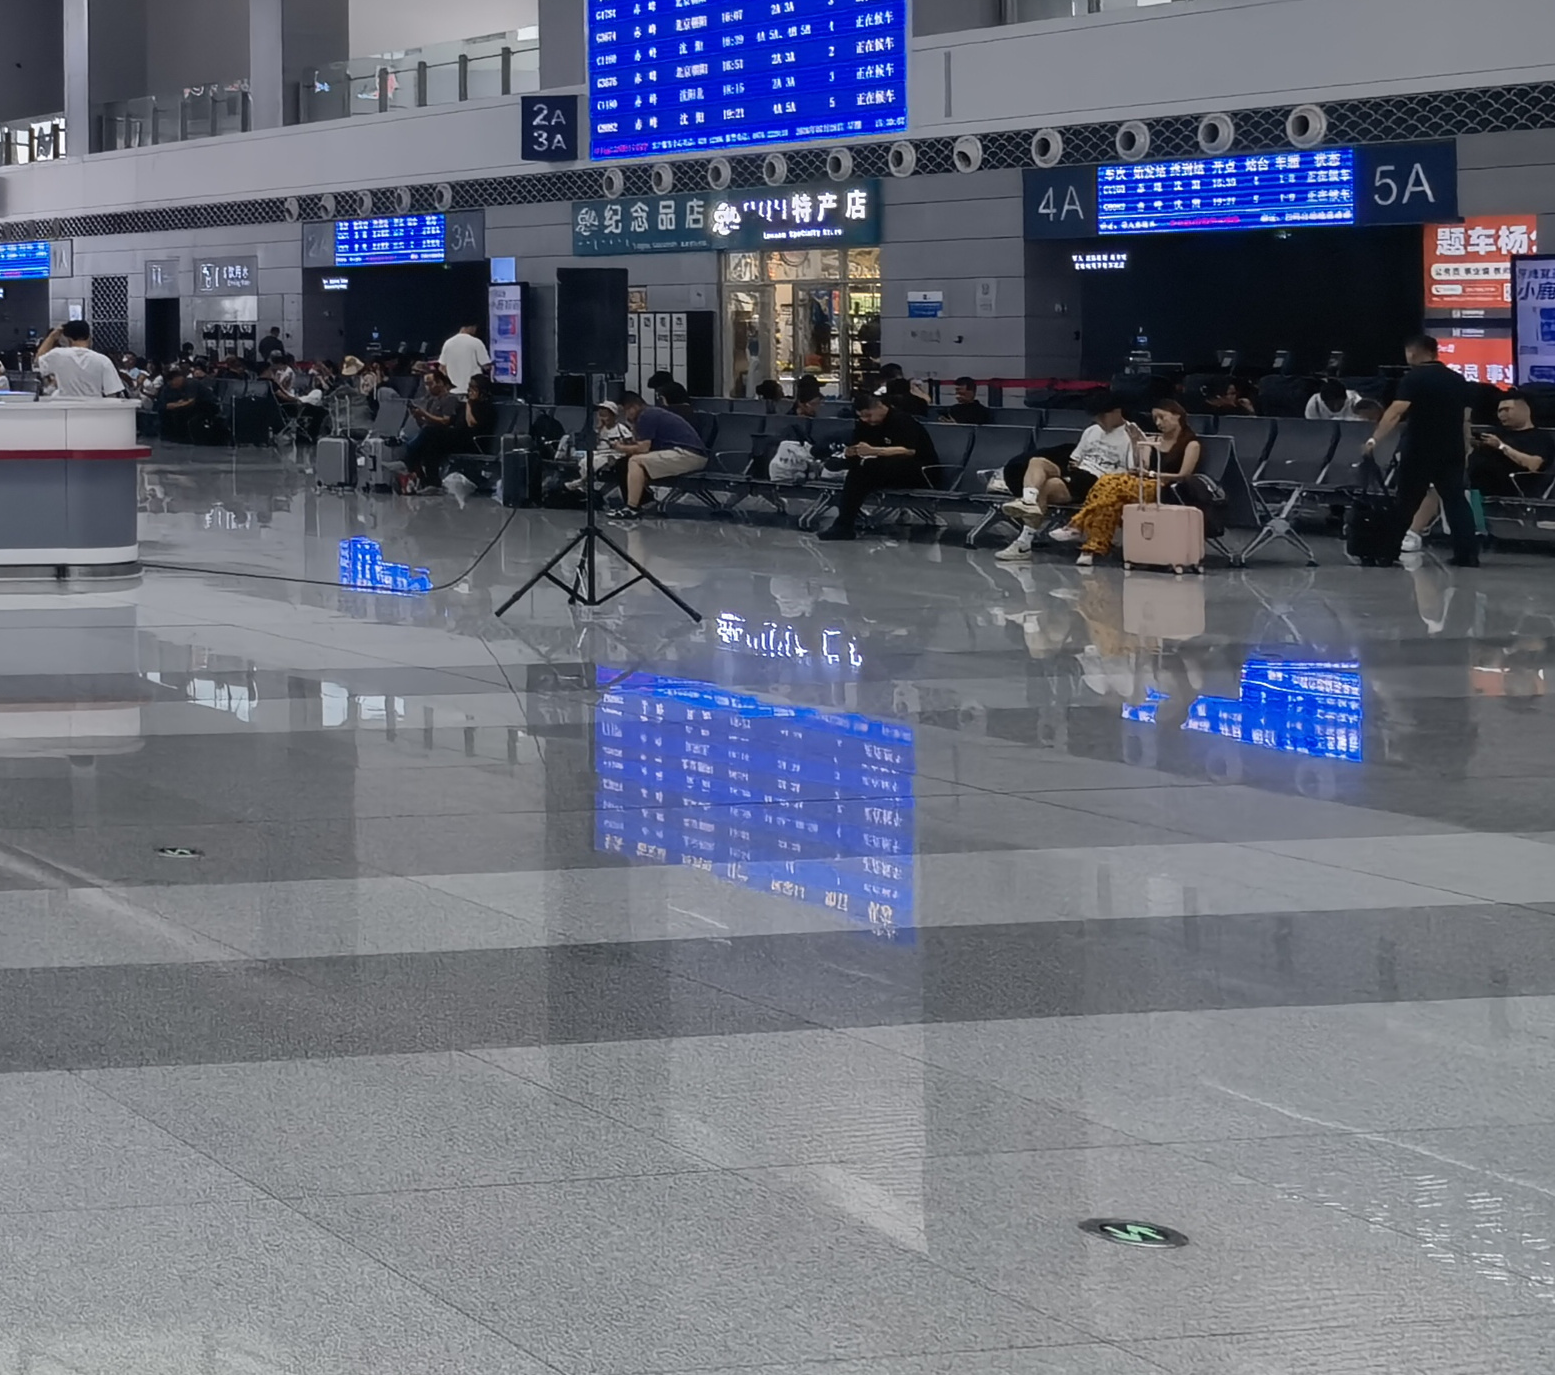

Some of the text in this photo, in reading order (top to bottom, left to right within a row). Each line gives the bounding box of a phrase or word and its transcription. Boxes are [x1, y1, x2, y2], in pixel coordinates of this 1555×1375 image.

[855, 10, 893, 28] 正在候车
[856, 36, 894, 54] 正在候车
[856, 62, 894, 80] 正在候车
[856, 89, 896, 106] 正在候车
[533, 104, 566, 126] 2A
[533, 131, 567, 151] 3A
[1105, 167, 1127, 181] 车次
[1212, 159, 1236, 174] 开点
[1245, 157, 1269, 172] 站台
[1314, 153, 1341, 167] 状态
[1373, 163, 1436, 206] 5A
[791, 190, 867, 223] 特产店
[1038, 185, 1084, 222] 4A
[603, 198, 705, 235] 纪念品店
[450, 224, 477, 251] 3A
